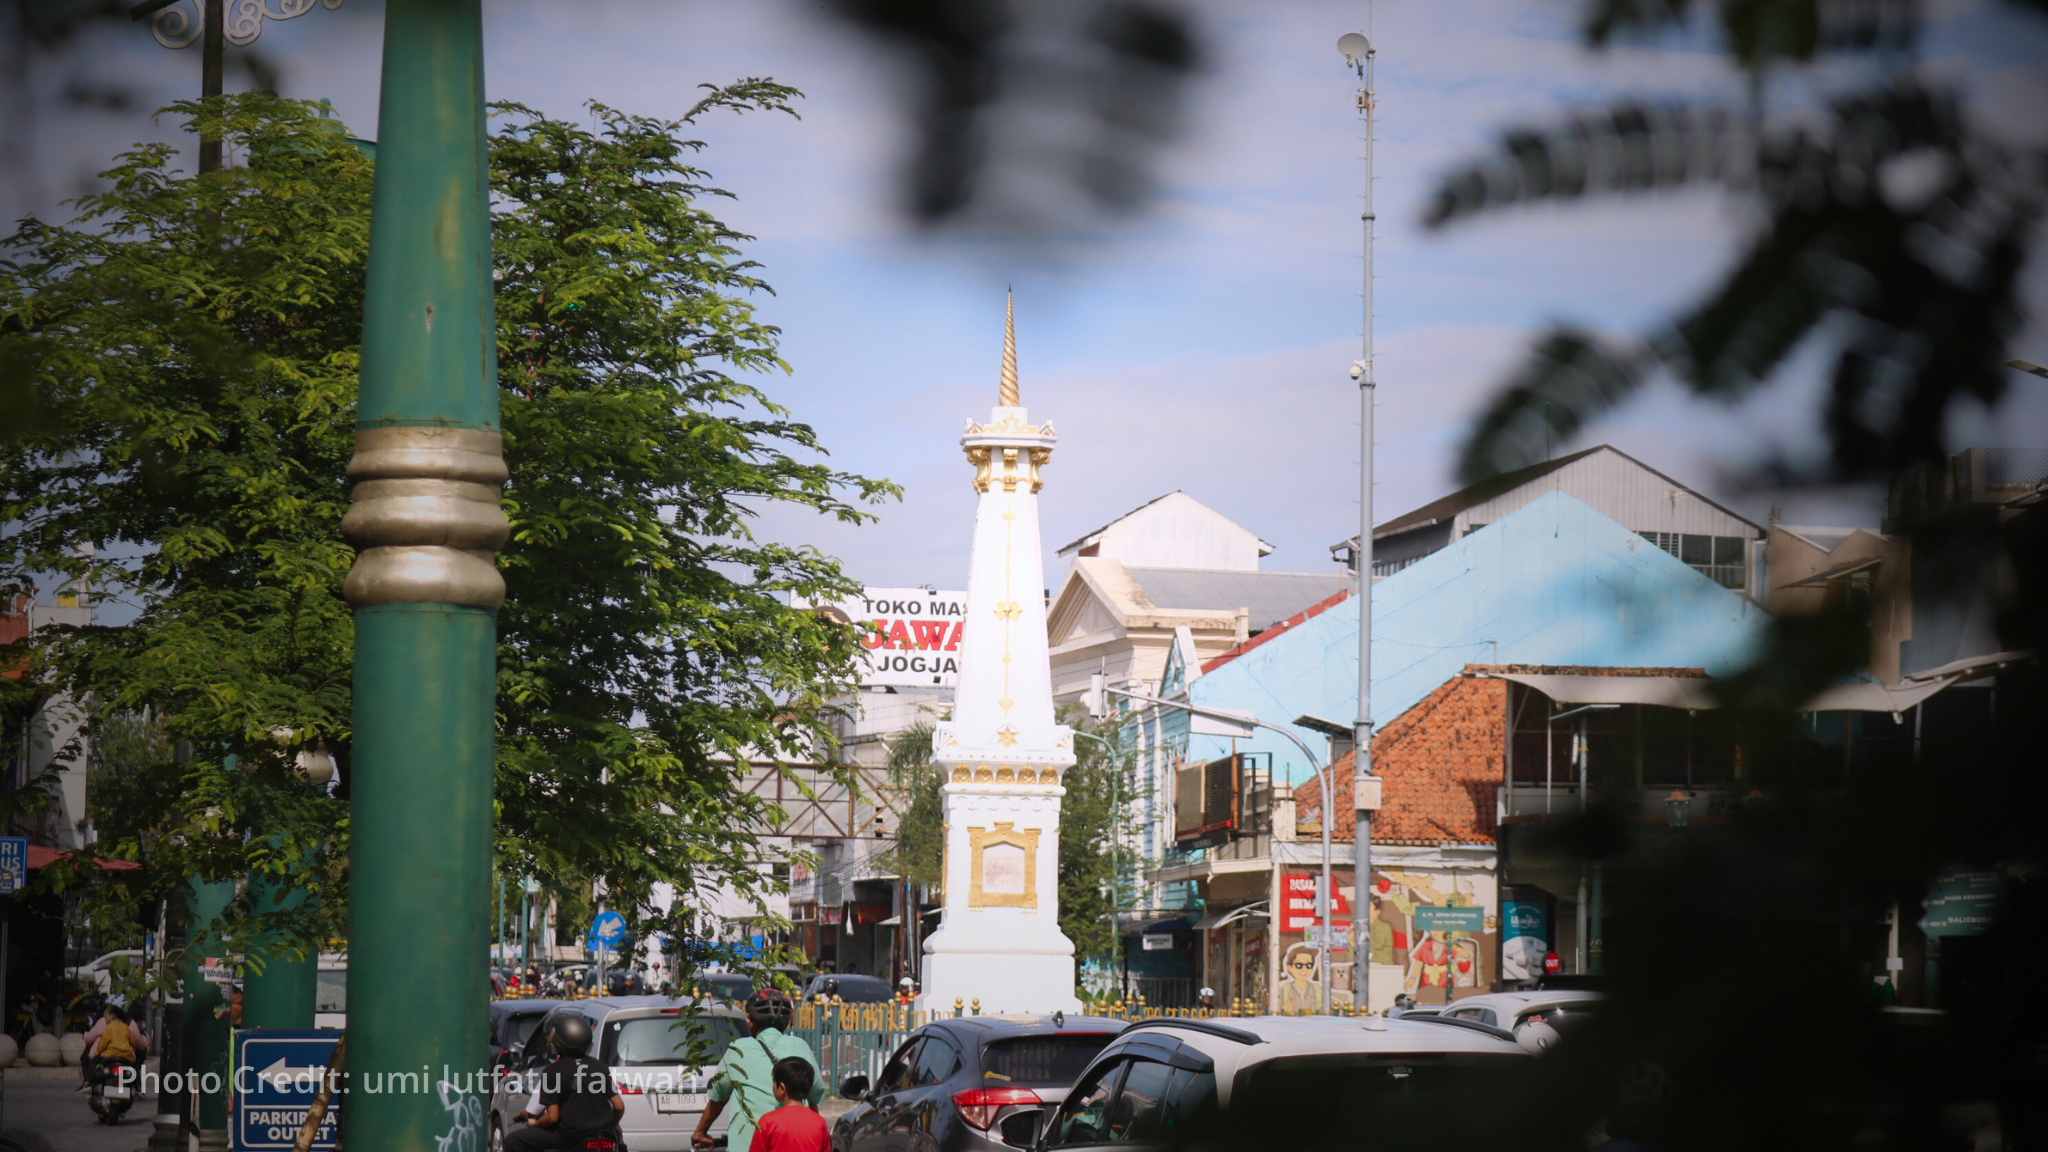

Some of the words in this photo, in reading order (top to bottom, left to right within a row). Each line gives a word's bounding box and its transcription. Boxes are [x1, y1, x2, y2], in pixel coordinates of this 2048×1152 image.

[862, 599, 922, 614] TOKO
[930, 602, 966, 616] MA
[861, 619, 965, 651] JAWA
[877, 656, 958, 673] JOGJA
[1290, 879, 1316, 891] RASAK
[1948, 916, 1993, 924] MALIOBORO
[1545, 959, 1559, 967] OUT
[660, 1096, 670, 1105] AB
[677, 1096, 696, 1104] 1093
[249, 1111, 309, 1125] PARKIR
[267, 1126, 330, 1140] OUTET
